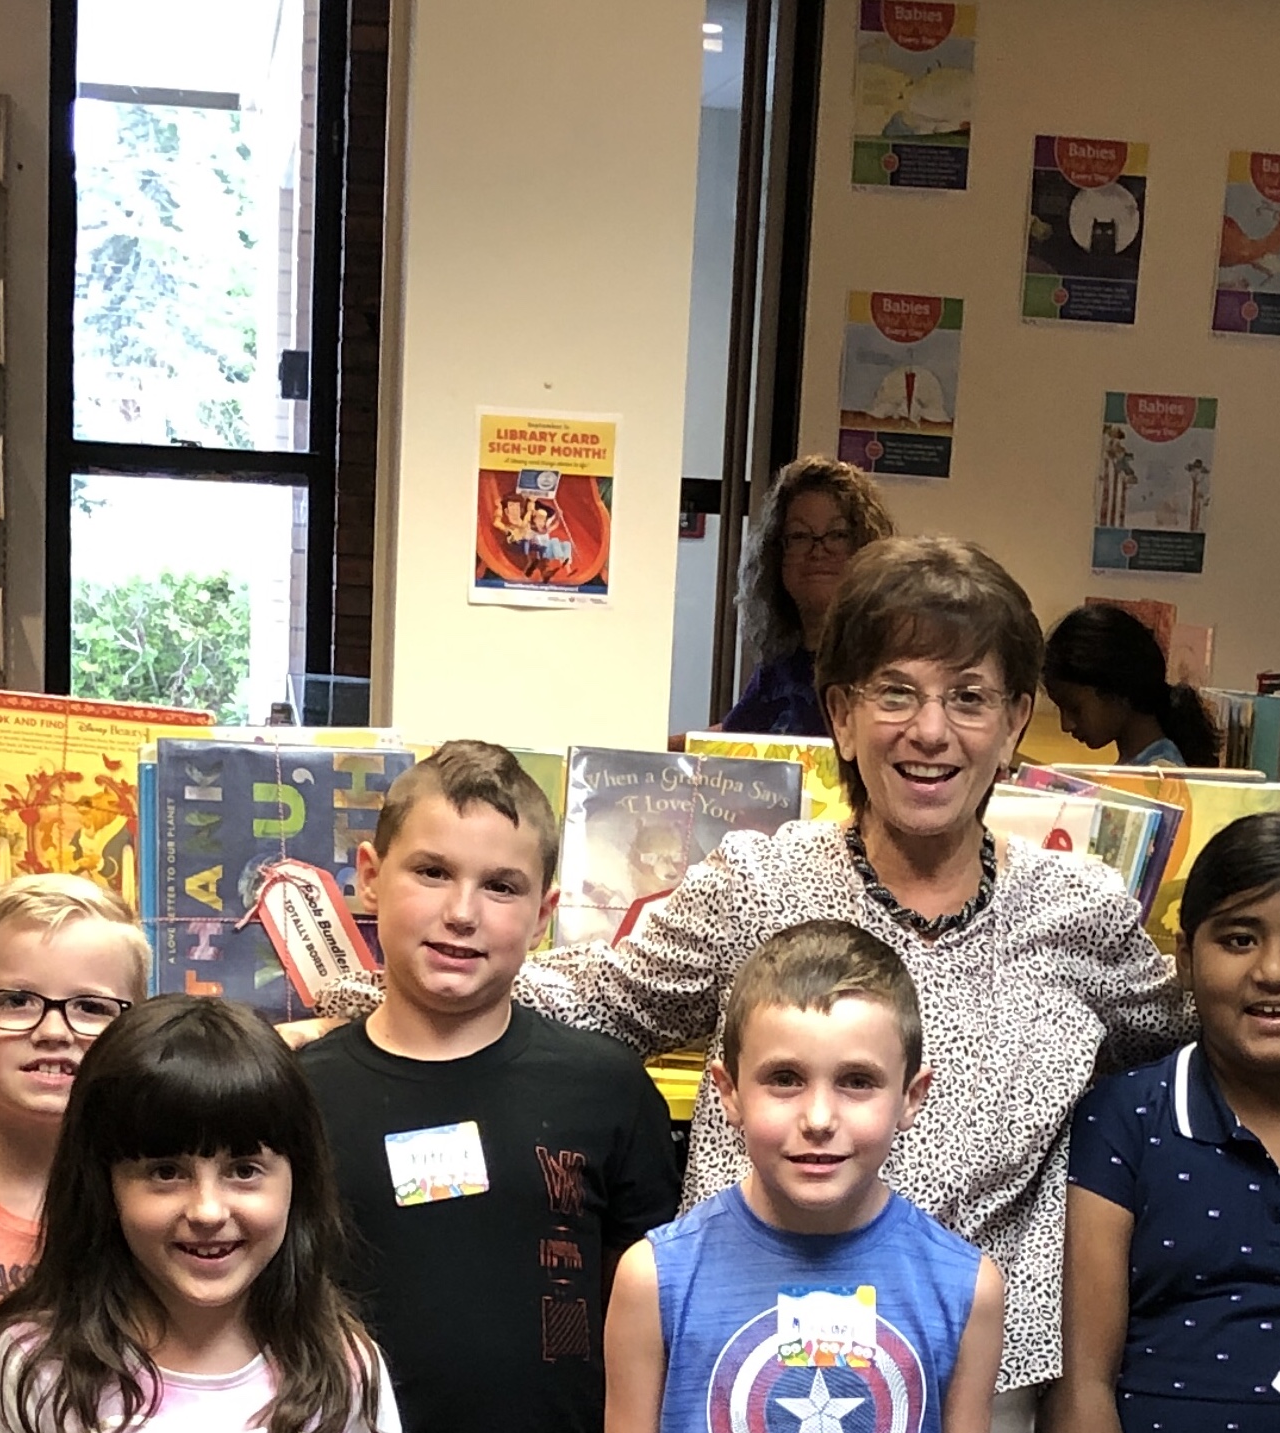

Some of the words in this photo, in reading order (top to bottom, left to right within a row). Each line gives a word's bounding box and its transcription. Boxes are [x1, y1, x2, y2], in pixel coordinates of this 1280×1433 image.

[894, 6, 943, 22] Babies
[1069, 142, 1116, 160] Babies
[882, 298, 931, 315] Babies
[1138, 399, 1185, 415] Babies
[496, 428, 557, 443] LIBRARY
[561, 432, 600, 445] CARD
[488, 441, 547, 456] SIGN-UP
[550, 446, 607, 460] MONTH!
[14, 716, 37, 728] AND
[40, 719, 65, 730] FIND
[77, 720, 108, 736] Disney
[585, 768, 639, 791] When
[645, 771, 655, 784] a
[660, 766, 743, 797] Grandpa
[748, 780, 791, 811] Says
[646, 795, 692, 814] Love
[166, 796, 177, 838] PLANET
[166, 841, 177, 864] OUR
[166, 867, 177, 882] TO
[184, 760, 224, 997] THANK
[166, 927, 177, 954] LOVE
[285, 900, 311, 943] TOTALLY
[306, 940, 328, 977] BORED
[167, 957, 177, 965] A
